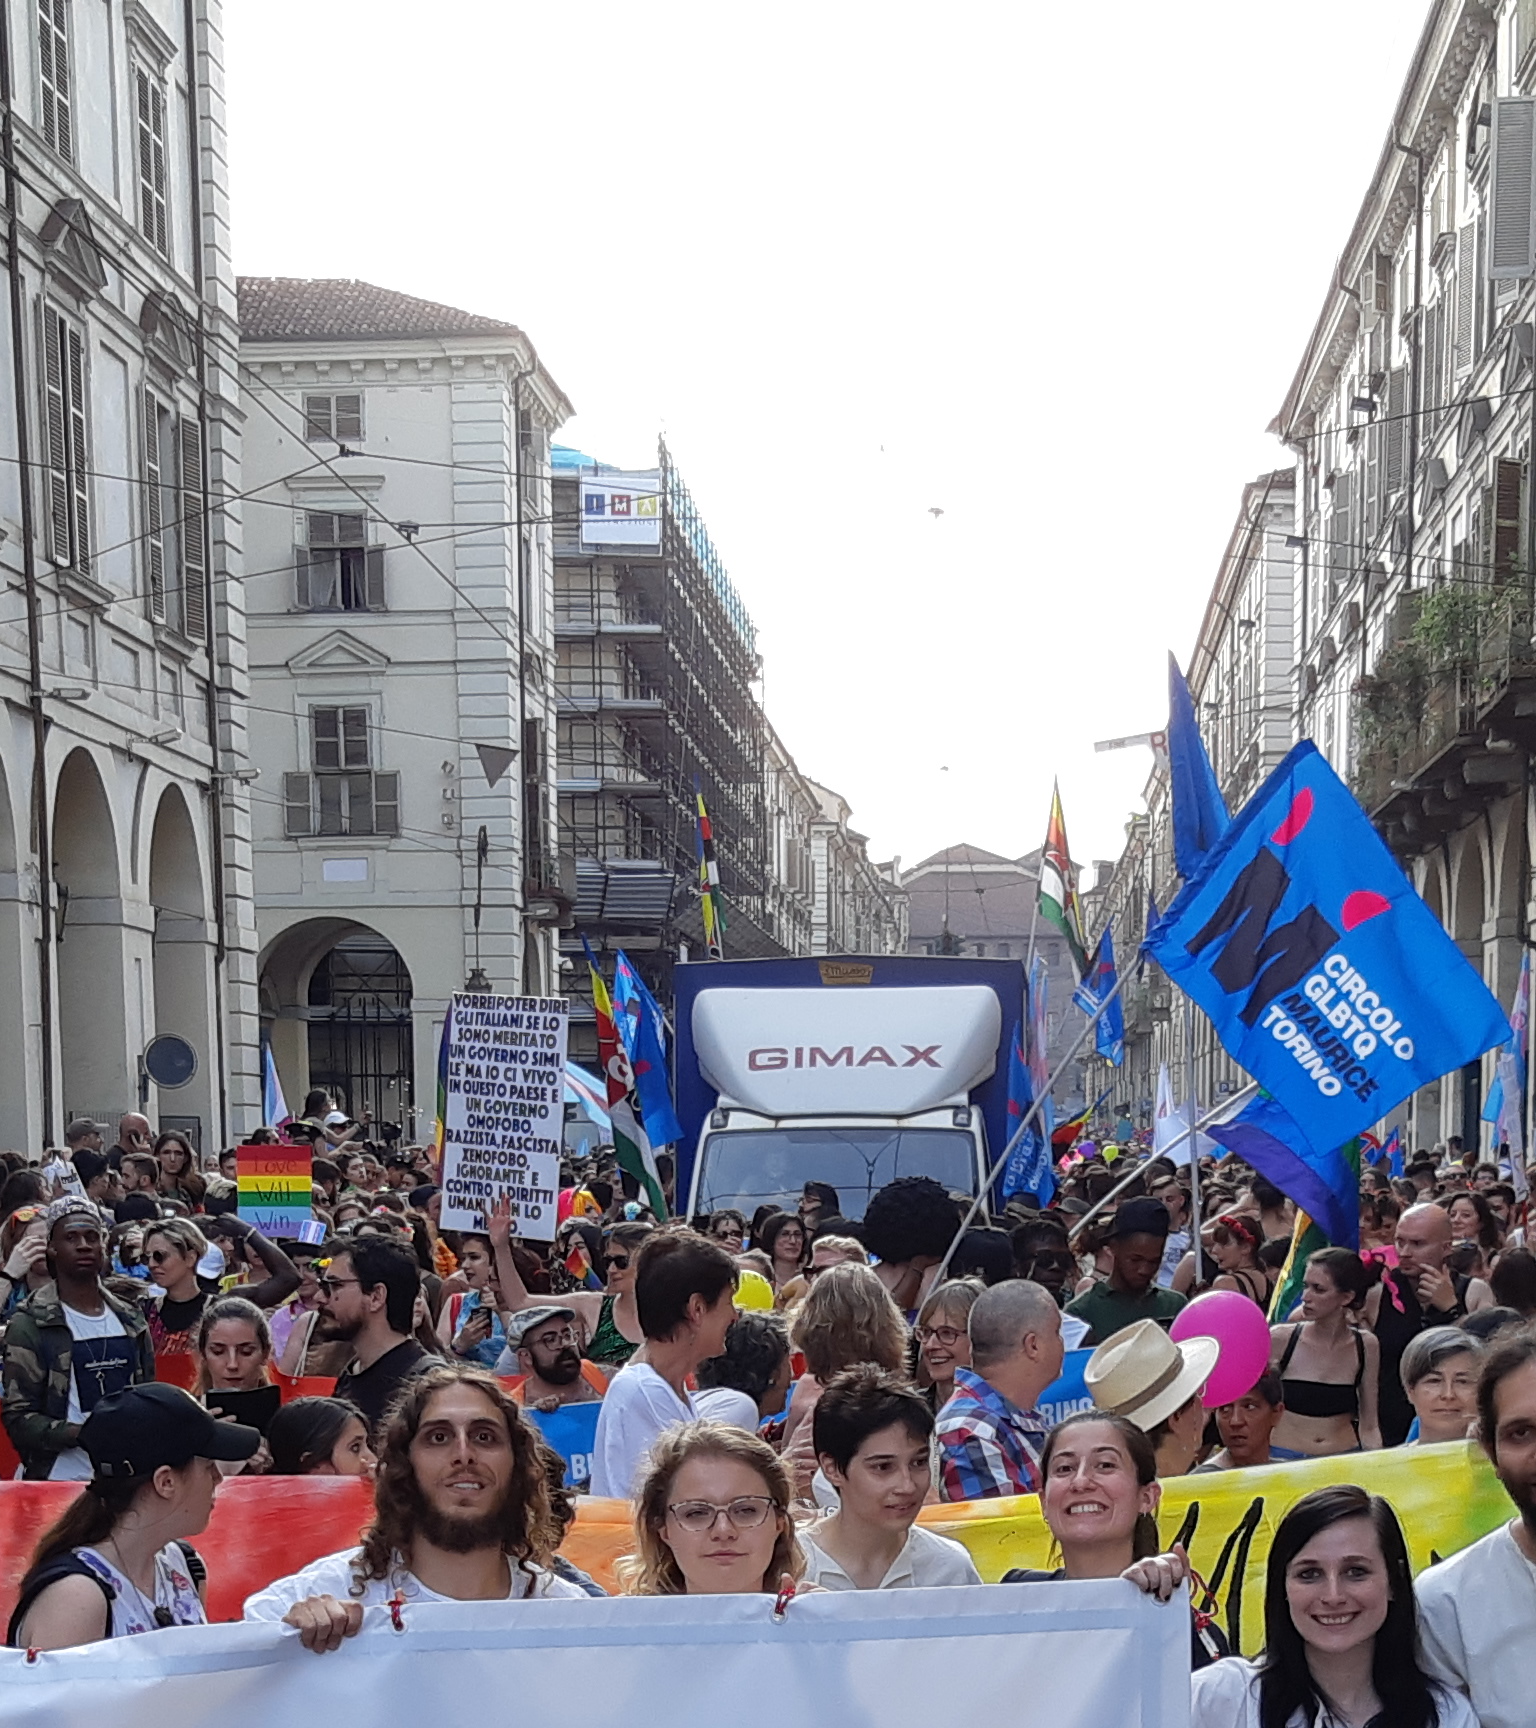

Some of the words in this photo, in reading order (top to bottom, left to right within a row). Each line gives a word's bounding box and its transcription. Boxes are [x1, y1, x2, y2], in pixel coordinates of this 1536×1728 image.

[454, 994, 496, 1011] VORREI
[497, 996, 537, 1012] POTER
[539, 1000, 569, 1014] DIRE
[1323, 953, 1415, 1061] CIRCOLO
[475, 1012, 524, 1029] ITALIANI
[525, 1015, 540, 1031] SE
[542, 1016, 560, 1031] LO
[1303, 973, 1378, 1060] GLBTQ
[457, 1027, 491, 1044] SONO
[449, 1044, 465, 1059] UN
[468, 1045, 529, 1065] GOVERNO
[748, 1045, 944, 1071] GIMAX
[1261, 1003, 1342, 1097] TORINO
[1280, 991, 1380, 1103] MAURICE
[465, 1063, 482, 1079] MA
[486, 1065, 499, 1081] IO
[504, 1067, 517, 1082] CI
[522, 1068, 557, 1086] VIVO
[449, 1079, 461, 1094] IN
[463, 1080, 507, 1098] QUESTO
[509, 1084, 548, 1103] PAESE
[551, 1089, 559, 1104] E
[466, 1097, 481, 1112] UN
[484, 1099, 549, 1119] GOVERNO
[467, 1114, 534, 1136] OMOFOBO,
[254, 1156, 297, 1174] Love
[462, 1148, 530, 1170] XENOFOBO,
[456, 1163, 525, 1185] IGNORANTE
[531, 1172, 539, 1187] E
[255, 1181, 291, 1202] Will
[446, 1179, 494, 1198] CONTRO
[506, 1186, 553, 1204] DIRITTI
[255, 1211, 290, 1230] Win
[524, 1204, 542, 1220] LO
